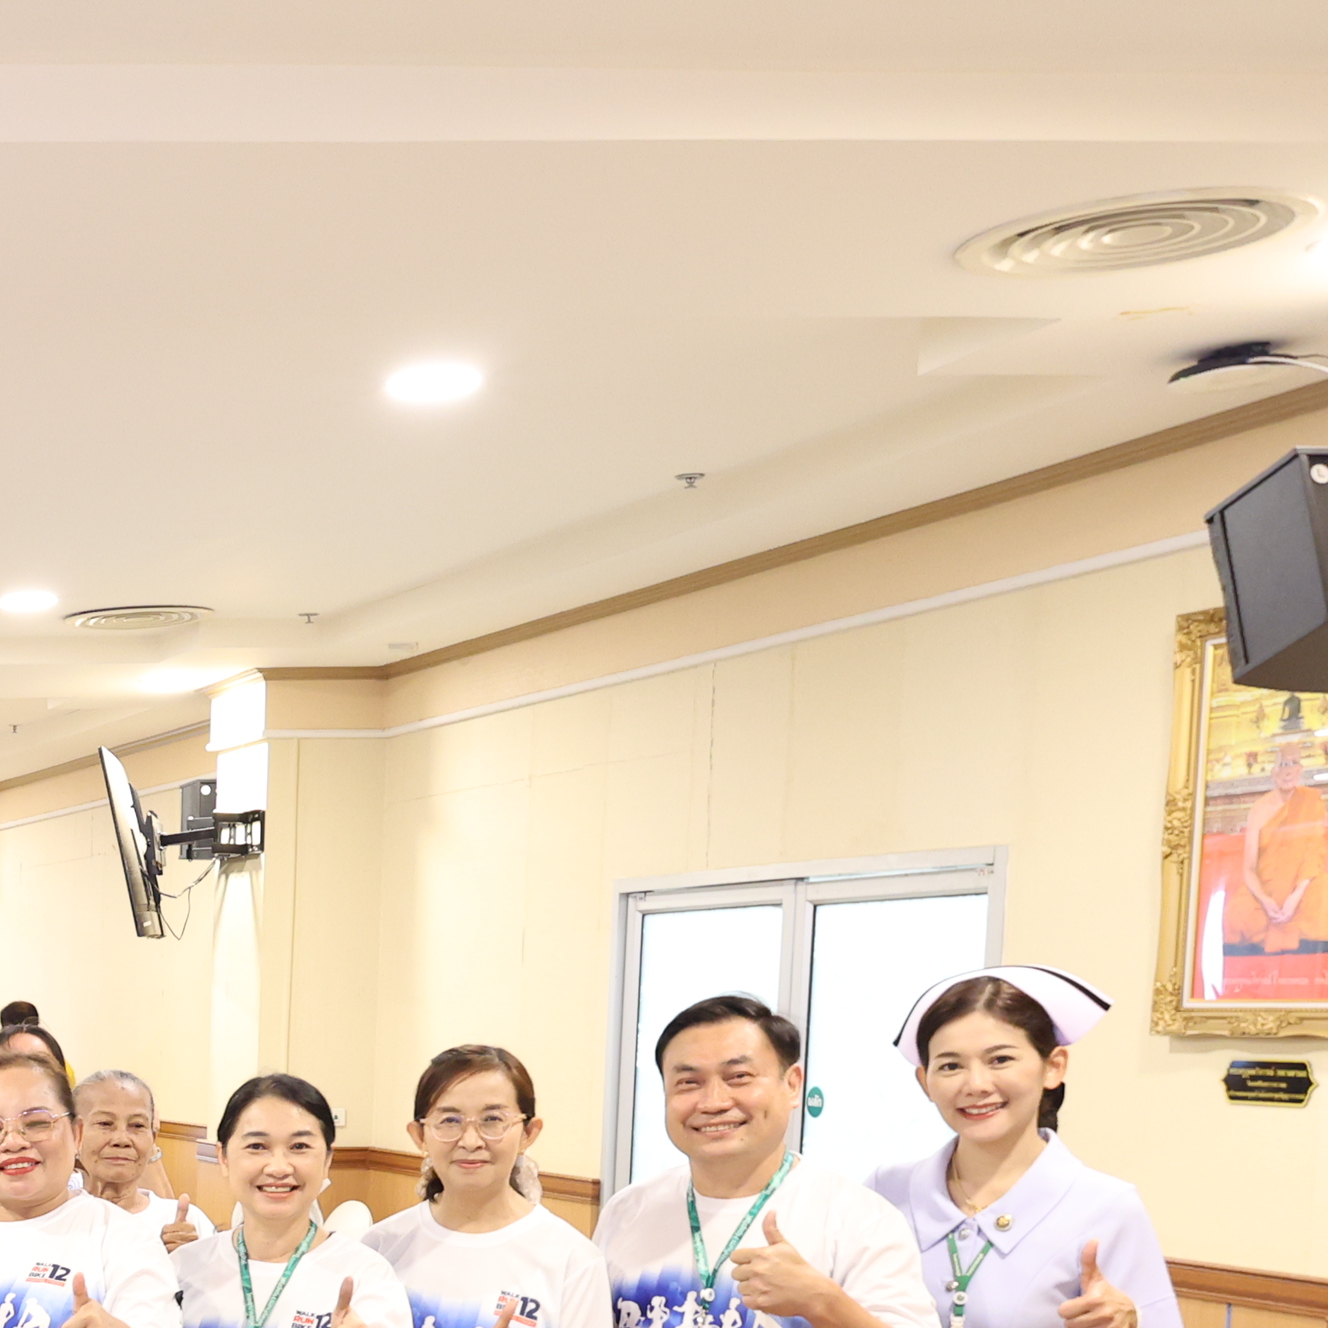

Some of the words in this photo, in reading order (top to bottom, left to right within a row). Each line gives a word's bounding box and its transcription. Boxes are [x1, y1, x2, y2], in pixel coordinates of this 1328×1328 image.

[48, 1264, 71, 1281] 12
[519, 1296, 540, 1320] 12
[294, 1315, 314, 1324] RUN
